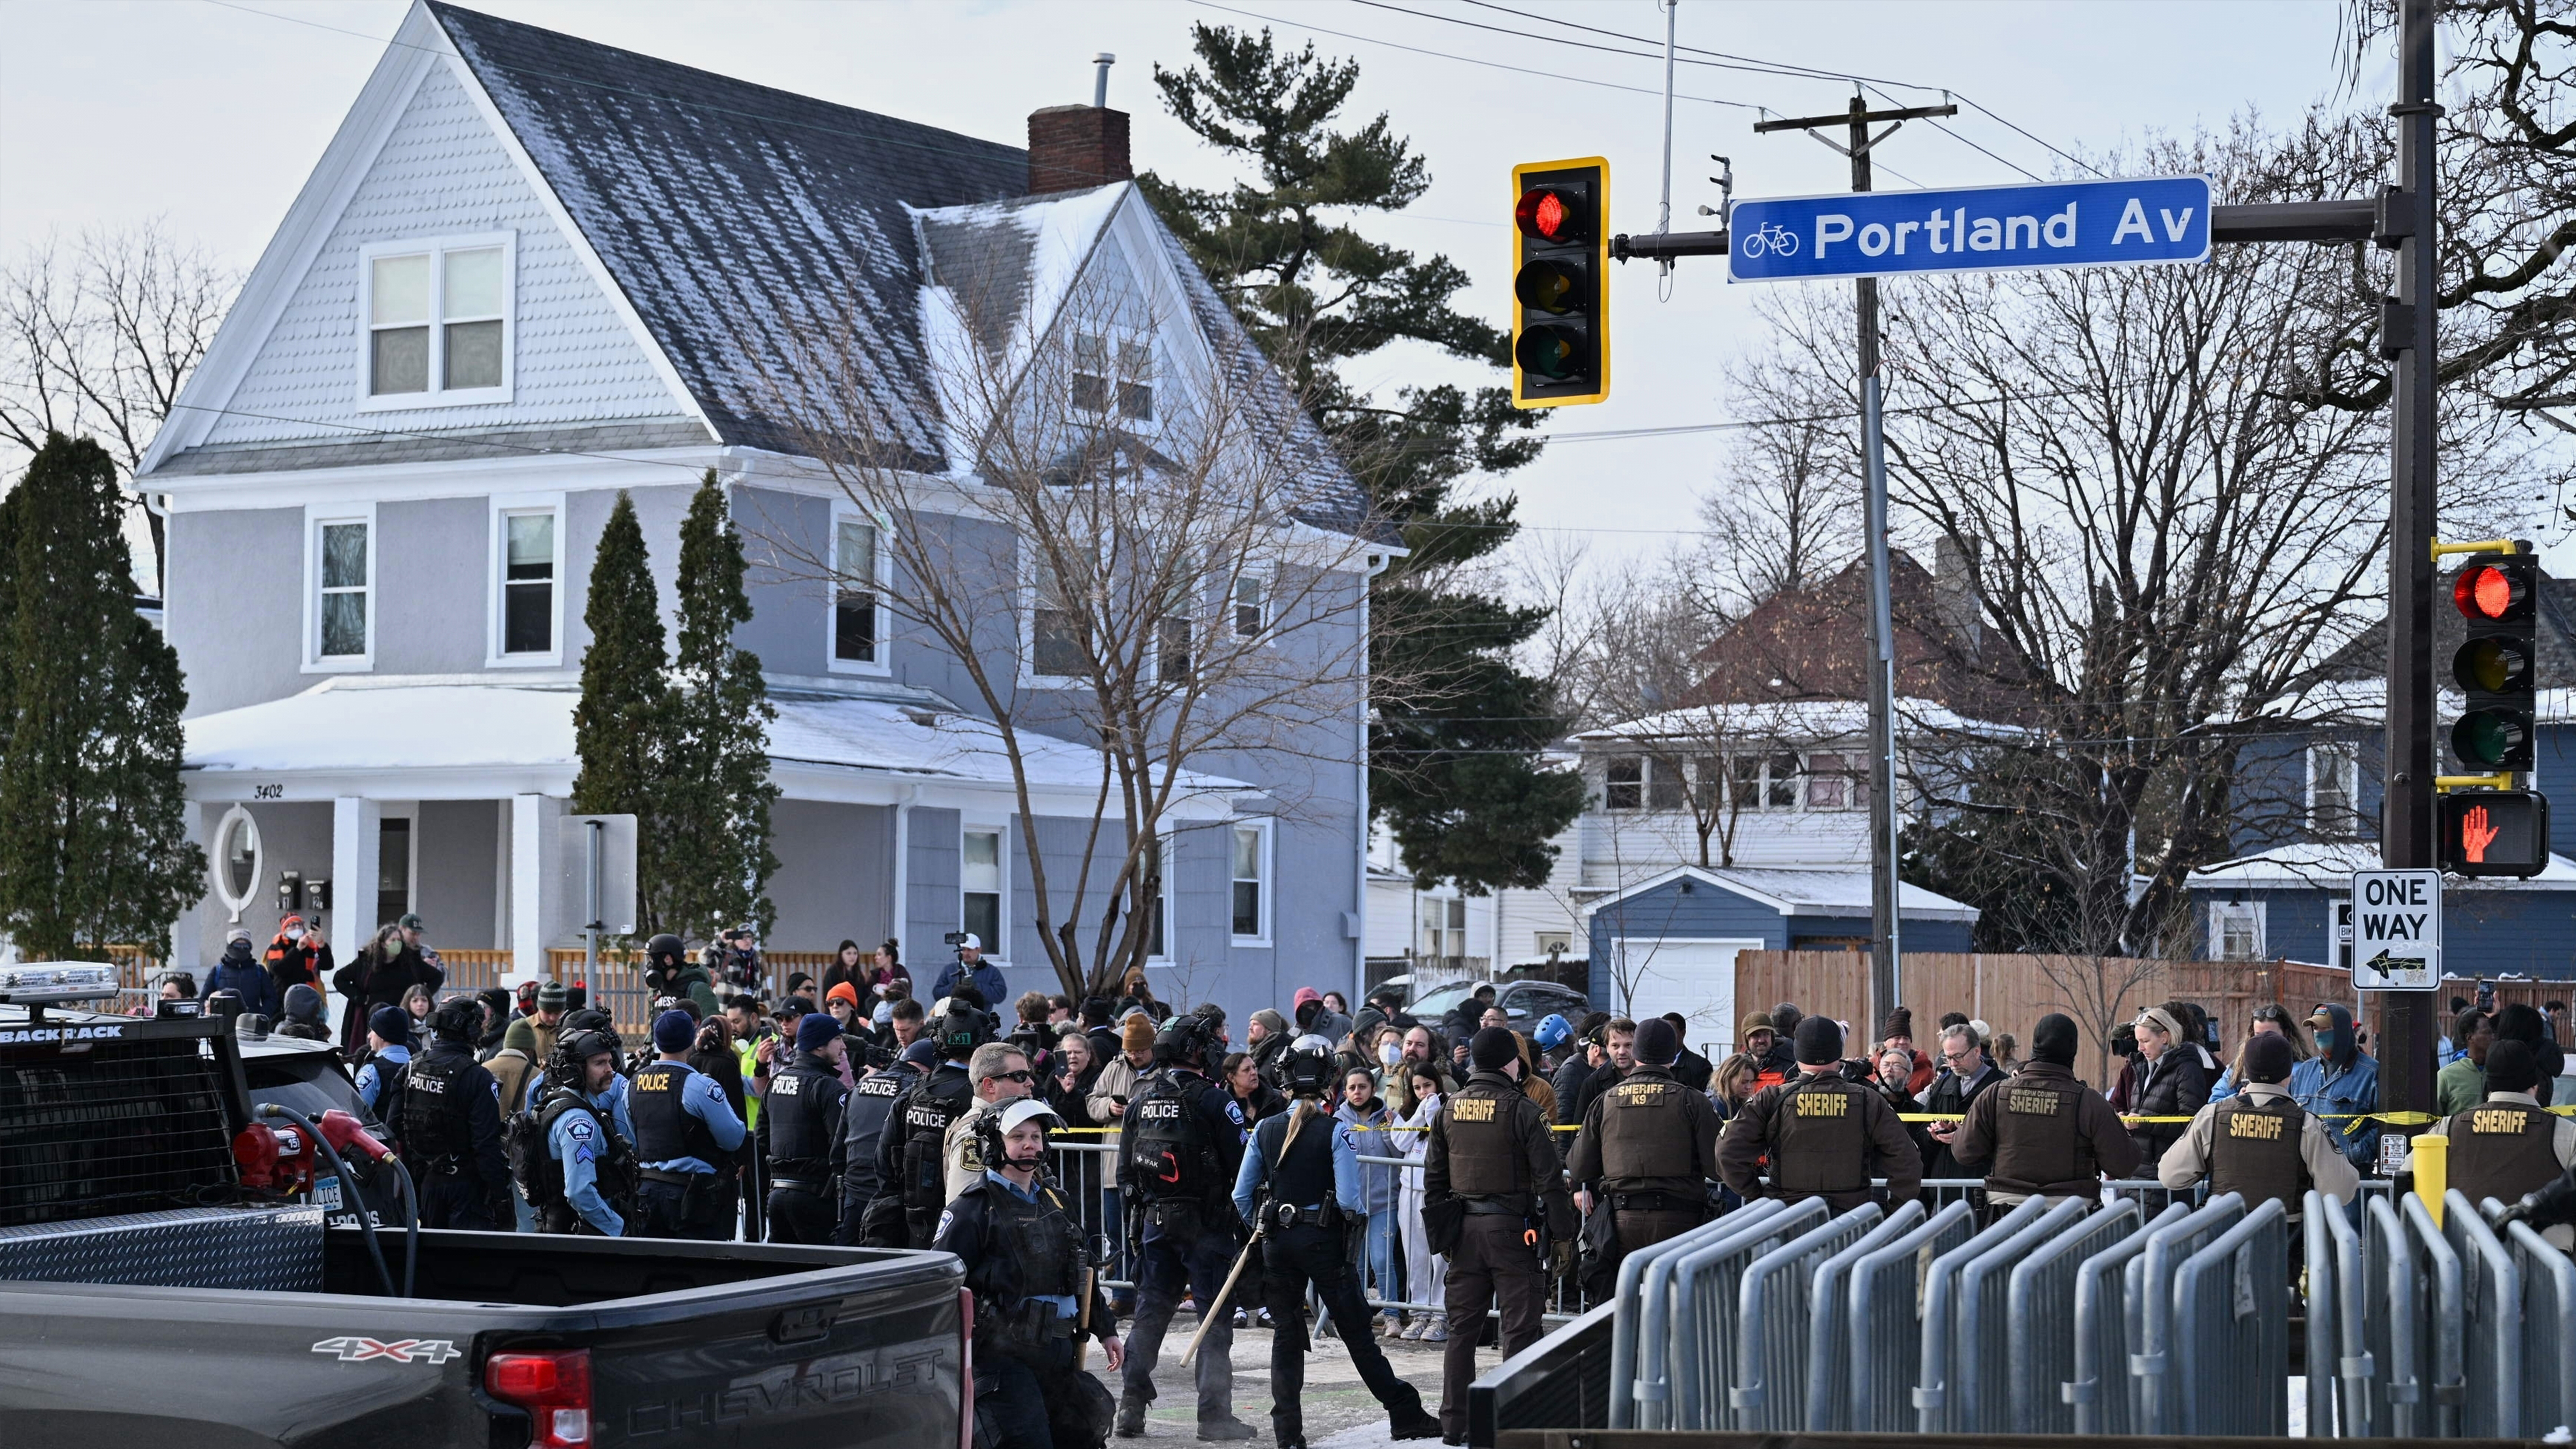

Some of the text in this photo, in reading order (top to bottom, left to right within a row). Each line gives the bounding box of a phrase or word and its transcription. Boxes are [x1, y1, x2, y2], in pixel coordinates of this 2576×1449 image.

[1814, 197, 2194, 259] Portland Av
[254, 785, 283, 800] 3402
[2365, 879, 2428, 906] ONE
[2363, 913, 2428, 940] WAY
[0, 1026, 123, 1043] BACKRACK
[409, 1075, 444, 1094] POLICE
[636, 1073, 670, 1091] POLICE
[771, 1079, 799, 1095] POLICE
[859, 1082, 898, 1096] POLICE
[1618, 1084, 1664, 1096] SHERIFF
[1632, 1094, 1646, 1105] K9
[2011, 1088, 2037, 1097] HENNEPIN
[1141, 1104, 1180, 1118] POLICE
[1453, 1099, 1496, 1121] SHERIFF
[1796, 1093, 1847, 1116] SHERIFF
[2009, 1095, 2058, 1115] SHERIFF
[906, 1110, 946, 1128] POLICE
[2229, 1113, 2284, 1140] SHERIFF
[2472, 1109, 2528, 1133] SHERIFF
[1144, 1158, 1159, 1168] IFAK
[312, 1187, 339, 1205] LICE
[628, 1348, 944, 1437] CHEVROLET
